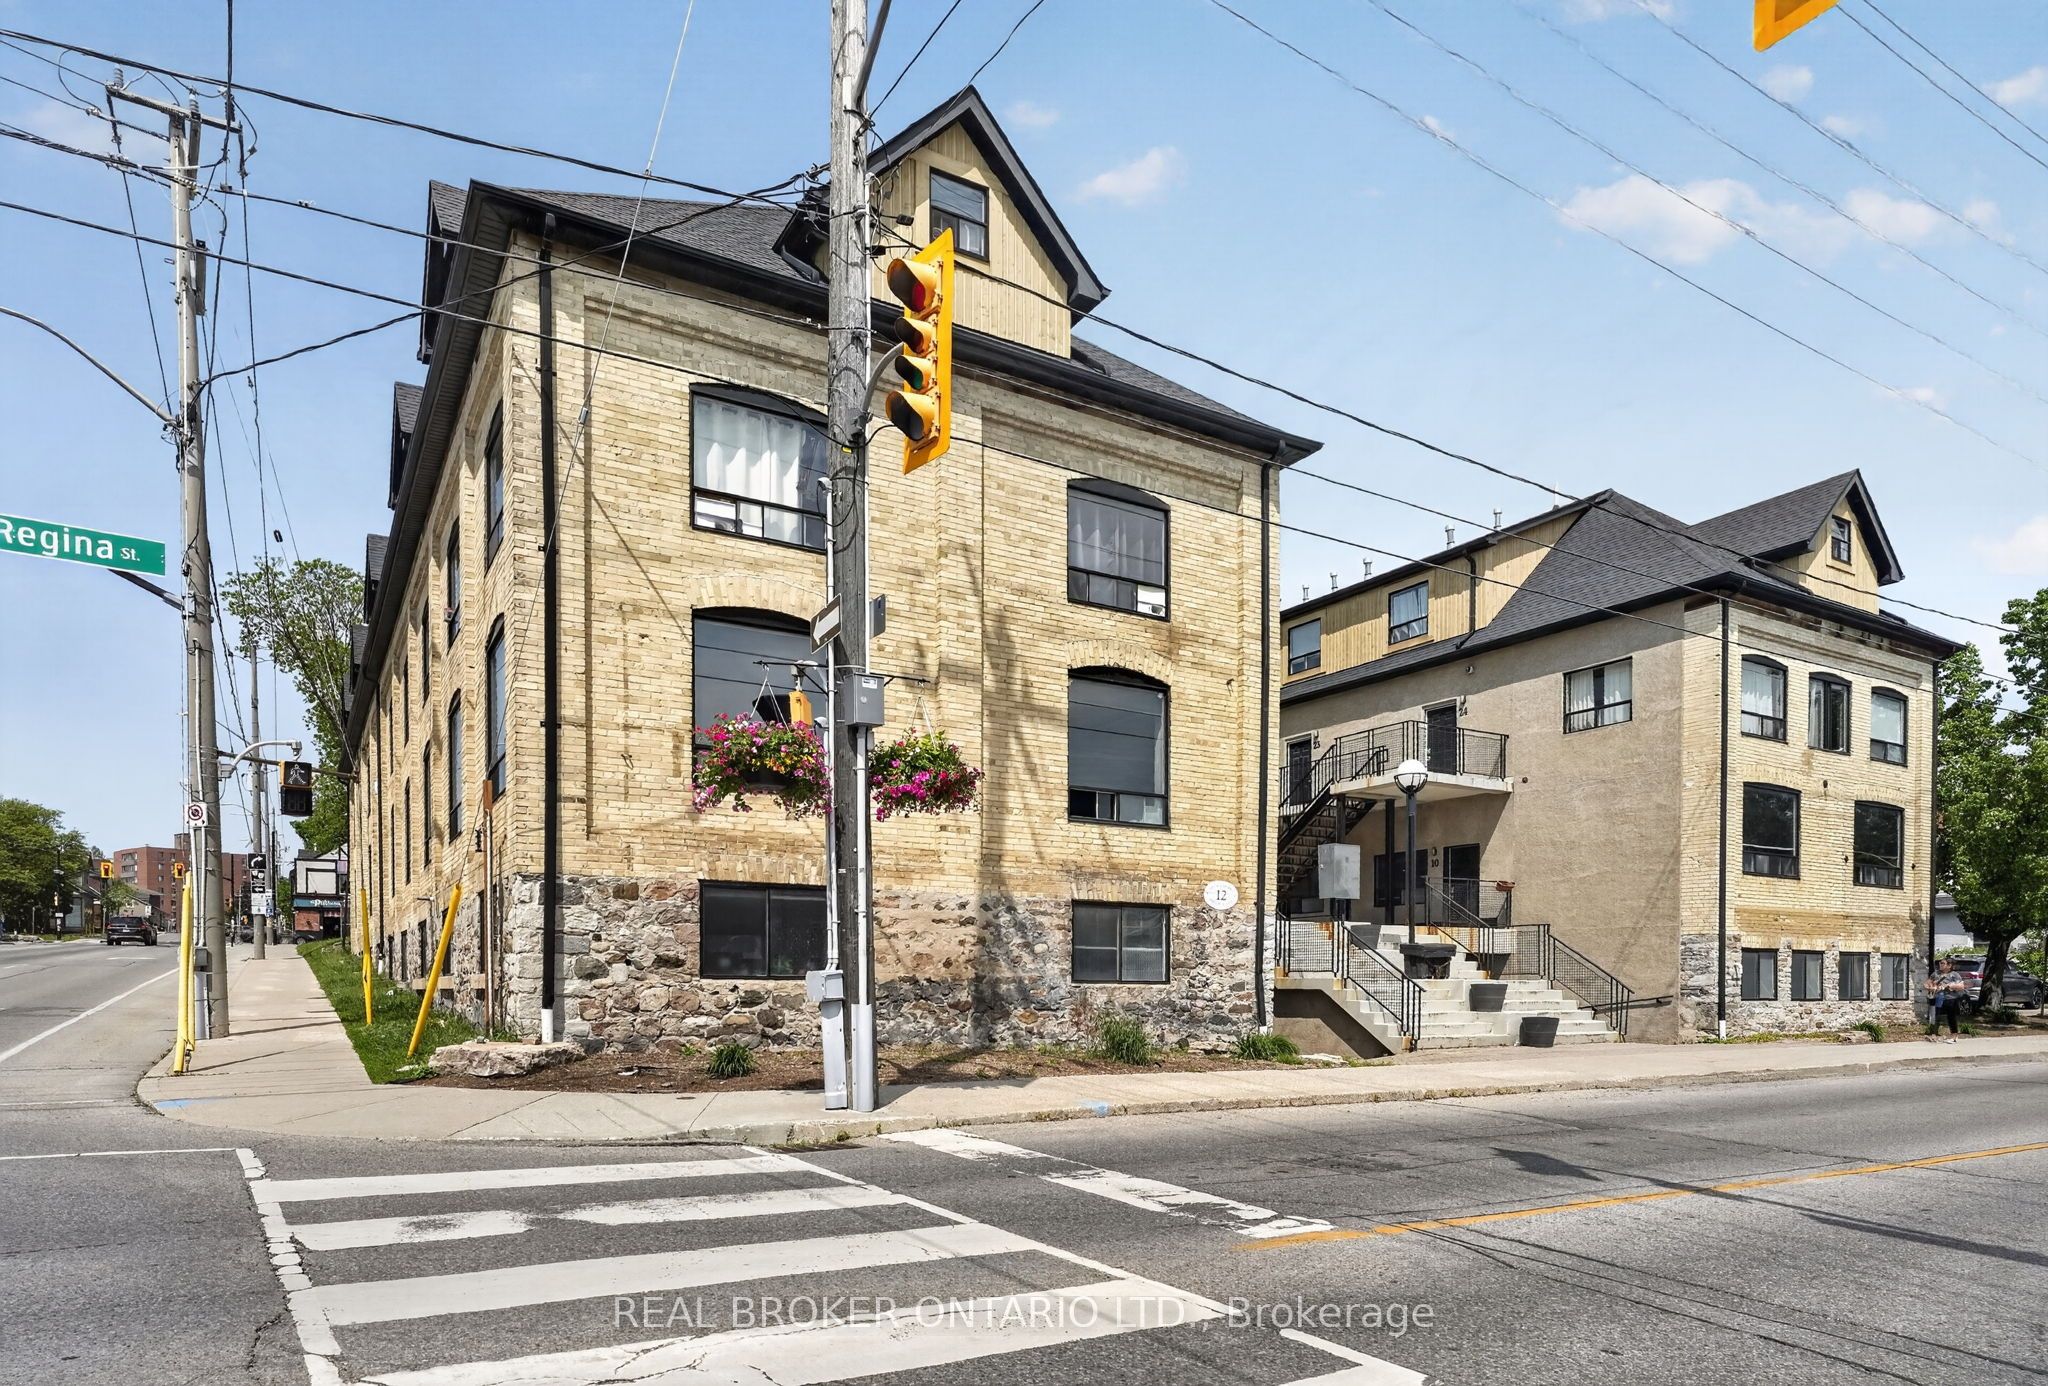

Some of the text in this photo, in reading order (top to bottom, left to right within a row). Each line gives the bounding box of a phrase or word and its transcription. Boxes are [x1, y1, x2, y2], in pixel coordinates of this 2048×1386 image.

[0, 518, 141, 562] Regina St.
[1431, 858, 1440, 868] 10
[1216, 889, 1227, 901] 12
